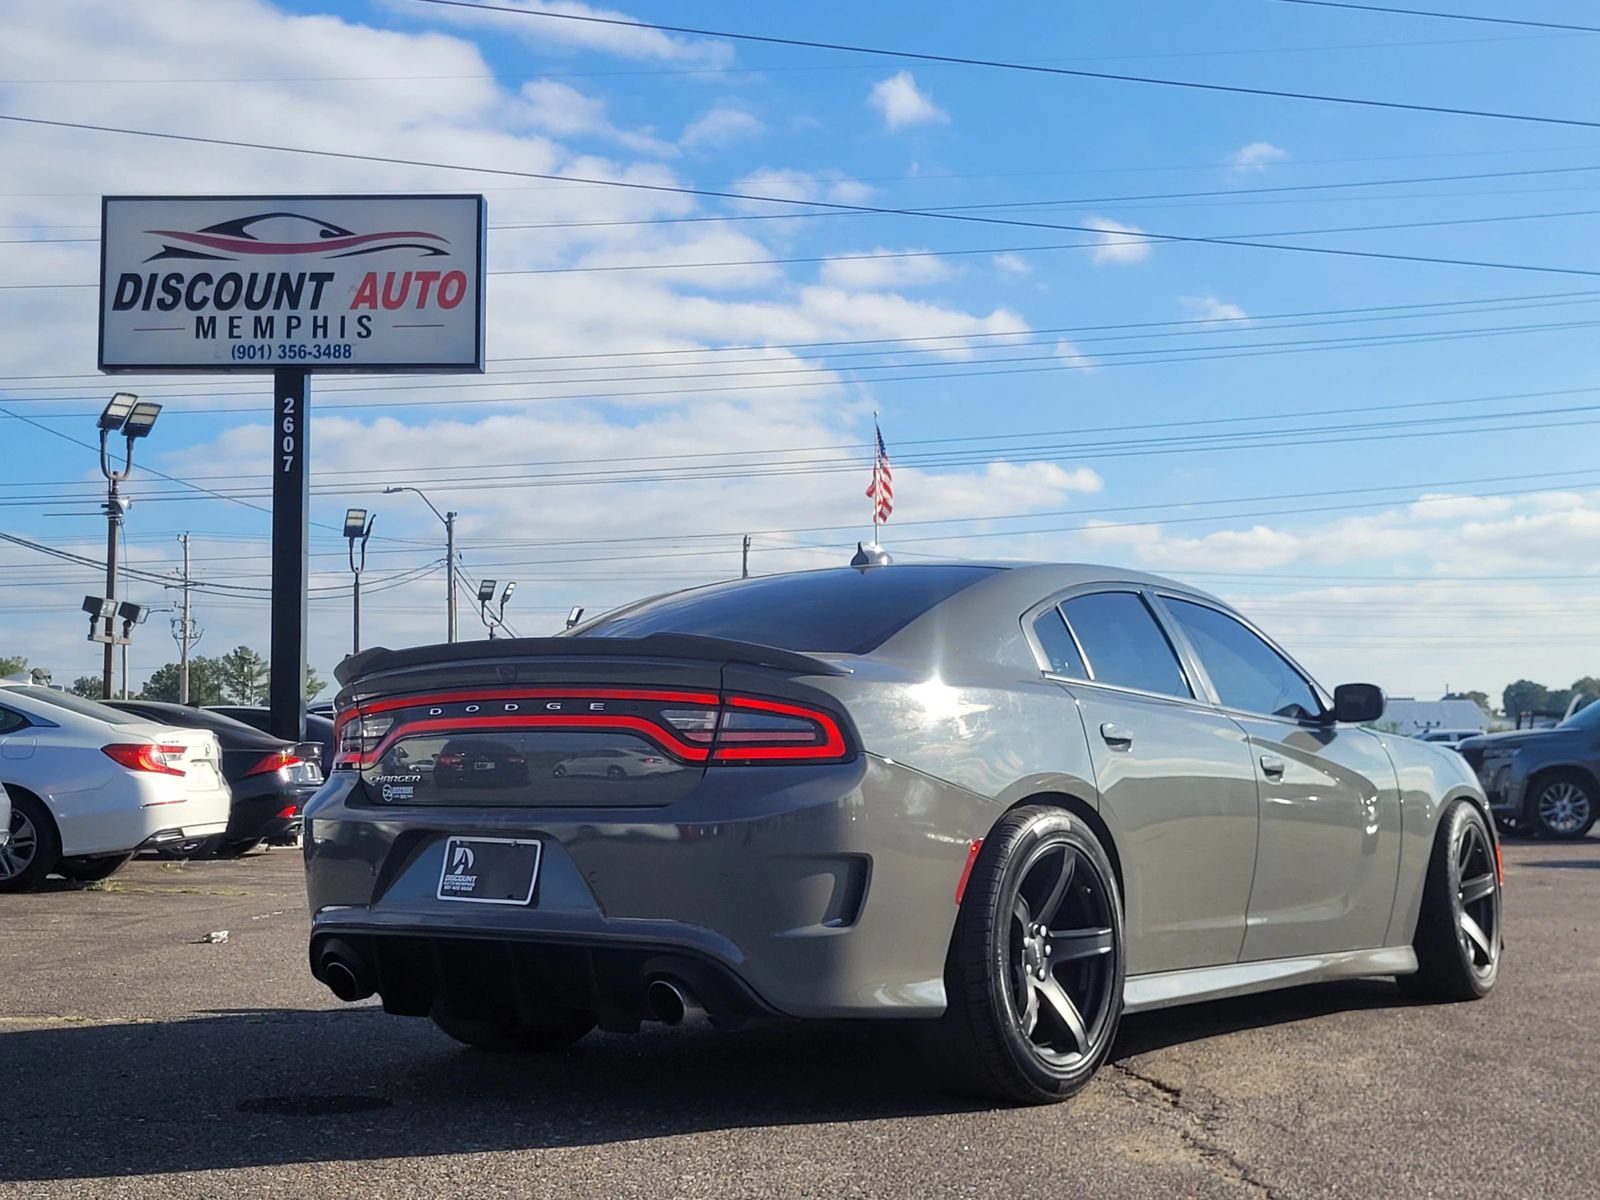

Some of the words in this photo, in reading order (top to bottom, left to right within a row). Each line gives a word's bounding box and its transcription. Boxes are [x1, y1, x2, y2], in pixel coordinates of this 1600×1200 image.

[112, 272, 335, 311] DISCOUNT
[349, 270, 467, 310] AUTO
[195, 315, 372, 339] MEMPHIS
[231, 344, 272, 360] (901)
[278, 344, 352, 359] 356-3488
[283, 397, 295, 472] 2607
[429, 702, 605, 715] DODGE
